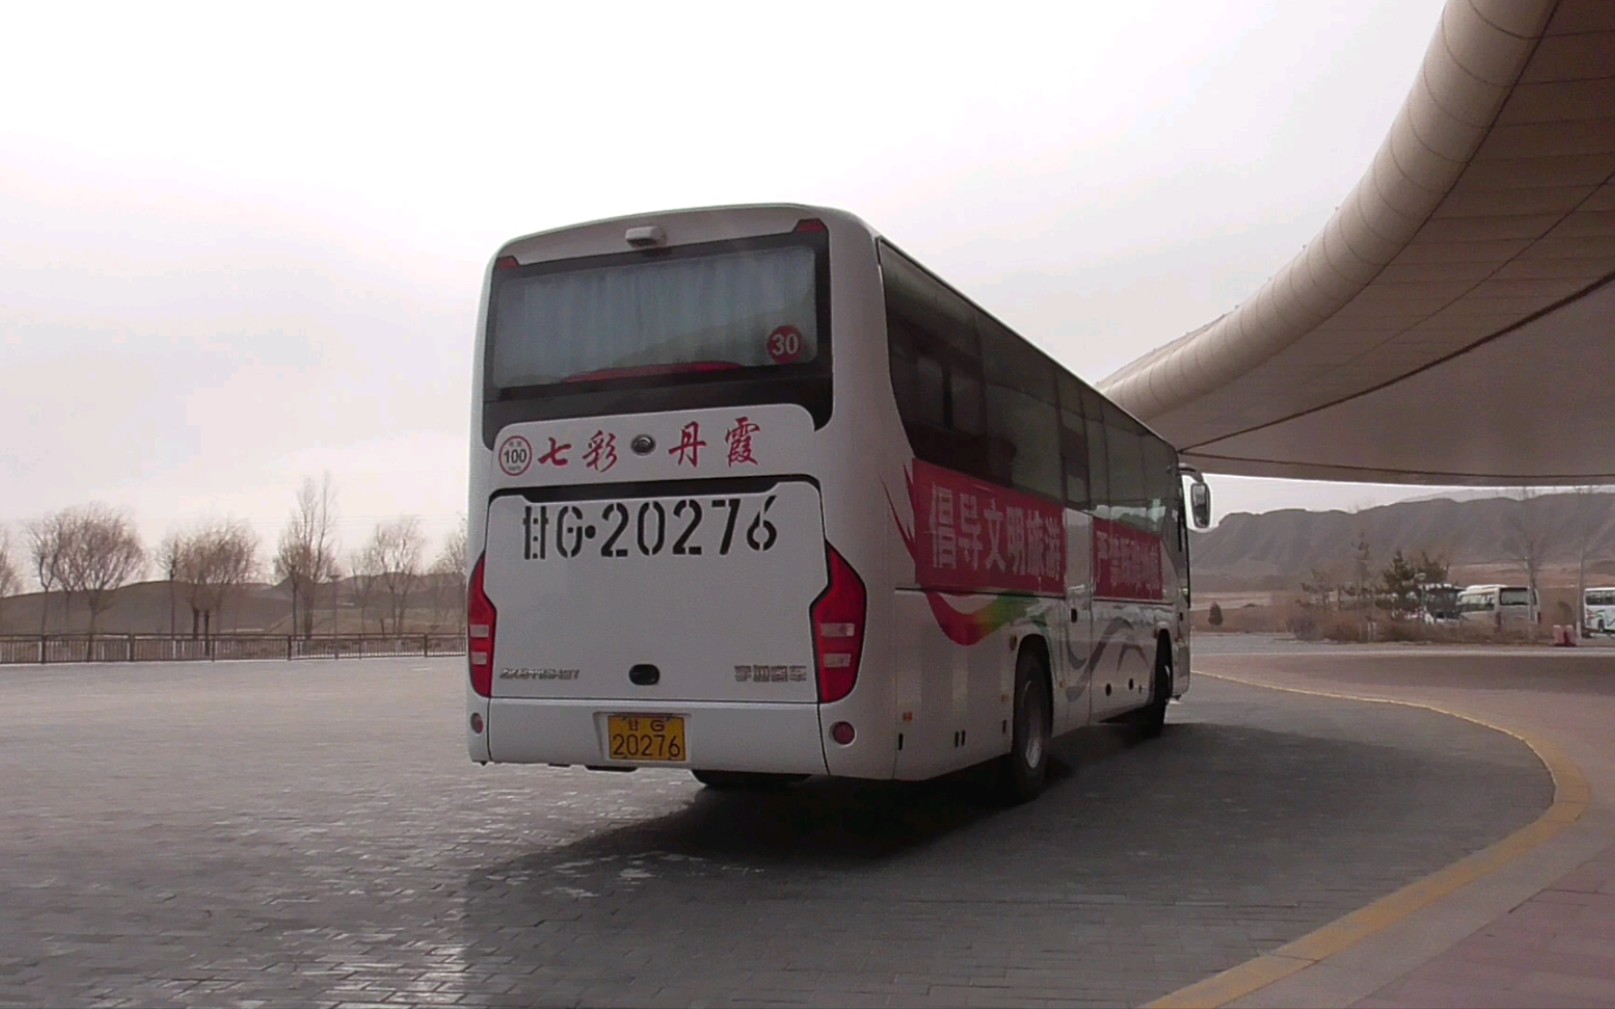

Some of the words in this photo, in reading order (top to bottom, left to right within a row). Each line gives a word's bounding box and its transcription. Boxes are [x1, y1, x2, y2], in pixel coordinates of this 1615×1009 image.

[772, 333, 799, 356] 30
[504, 448, 527, 464] 100
[538, 416, 760, 473] 七彩丹霞
[929, 481, 1061, 582] 倡导文明旅游
[612, 733, 681, 757] 20276
